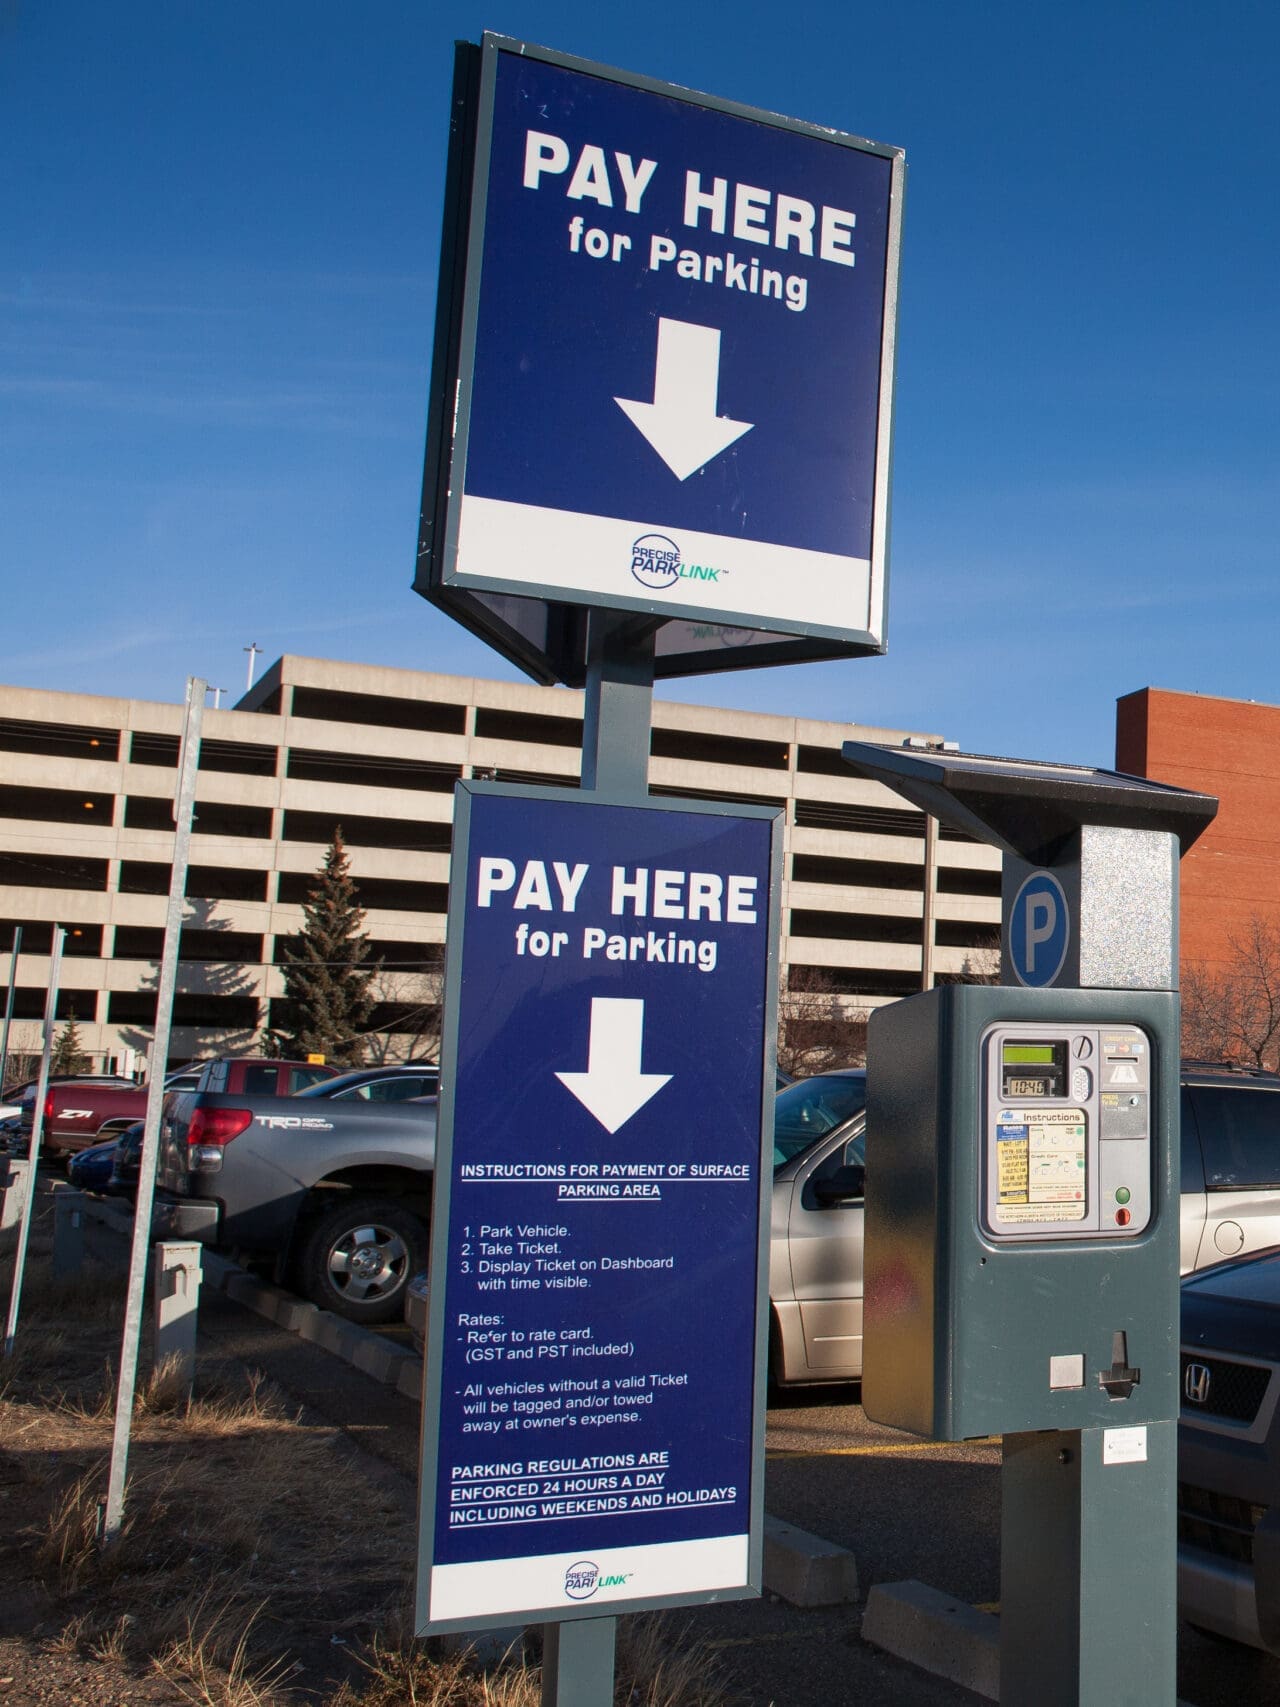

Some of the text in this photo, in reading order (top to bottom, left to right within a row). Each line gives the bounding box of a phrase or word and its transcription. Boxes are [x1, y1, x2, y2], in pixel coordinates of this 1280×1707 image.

[523, 130, 856, 267] PAY HERE
[568, 216, 808, 312] for Parking
[632, 547, 681, 562] PRECISE
[477, 856, 758, 924] PAY HERE
[1025, 891, 1057, 973] P
[515, 923, 718, 972] for Parking
[1015, 1081, 1043, 1093] 10:40
[57, 1109, 93, 1119] Z71
[254, 1116, 301, 1129] TRD
[1024, 1113, 1080, 1121] Instructions
[461, 1164, 750, 1177] INSTRUCTIONS FOR PAYMENT OF SURFACE
[558, 1184, 661, 1197] PARKING AREA
[463, 1225, 571, 1238] 1. Park Vehicle.
[461, 1242, 562, 1256] 2. Take Ticket.
[460, 1257, 674, 1275] 3. Display Ticket on Dashboard
[477, 1276, 592, 1291] with time visible.
[458, 1313, 505, 1326] Rates:
[511, 1330, 525, 1342] to
[529, 1329, 556, 1341] rate
[560, 1327, 594, 1340] card.
[465, 1342, 635, 1364] (GST and PST included)
[463, 1384, 483, 1397] All
[487, 1381, 545, 1396] vehicles
[549, 1378, 598, 1393] without
[601, 1381, 611, 1390] a
[615, 1375, 645, 1388] valid
[649, 1373, 688, 1386] Ticket
[463, 1392, 653, 1415] will be tagged and/or towed
[462, 1411, 642, 1434] away at owner's expense.
[452, 1451, 669, 1479] PARKING REGULATIONS ARE
[451, 1472, 666, 1502] ENFORCED 24 HOURS A DAY
[450, 1487, 737, 1524] INCLUDING WEEKENDS AND HOLIDAYS
